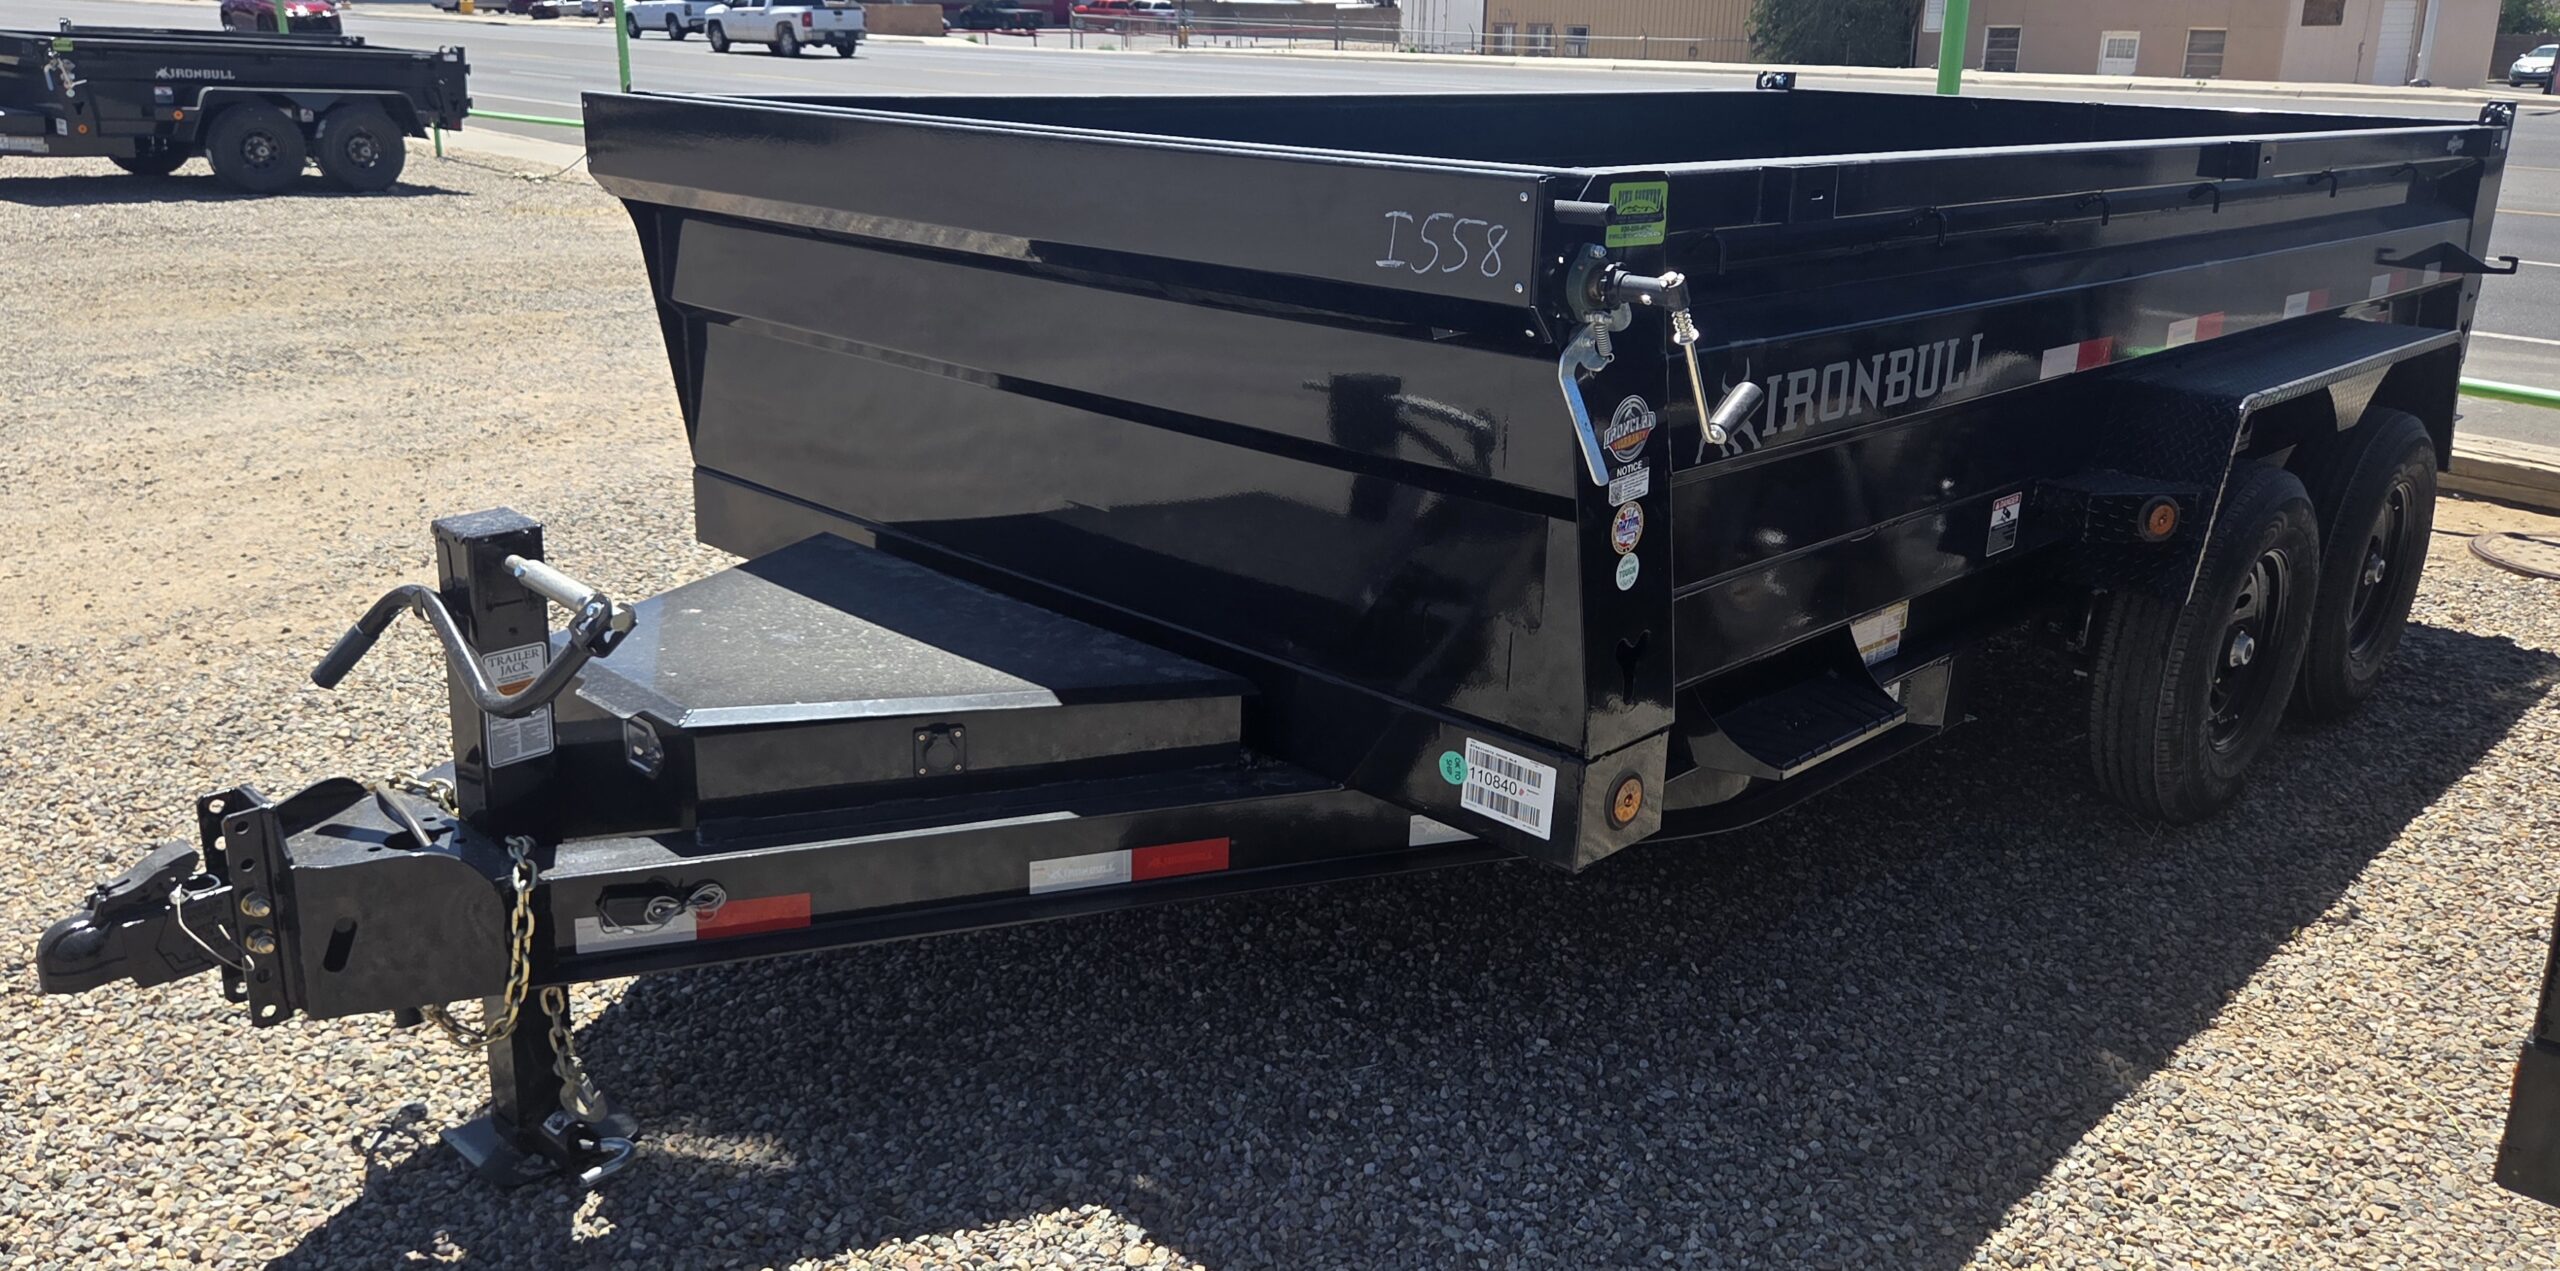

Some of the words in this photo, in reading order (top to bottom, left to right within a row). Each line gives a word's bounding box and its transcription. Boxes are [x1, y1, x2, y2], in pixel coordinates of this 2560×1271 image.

[169, 69, 235, 80] IRONBULL
[1376, 210, 1508, 277] I558
[1762, 333, 1989, 437] IRONBULL
[1606, 414, 1654, 445] IRONCLAD
[1616, 460, 1643, 477] NOTICE
[488, 648, 540, 668] TRAILER
[500, 661, 529, 676] JACK
[1454, 757, 1461, 768] OK
[1454, 771, 1461, 780] TO
[1469, 766, 1517, 796] 110840
